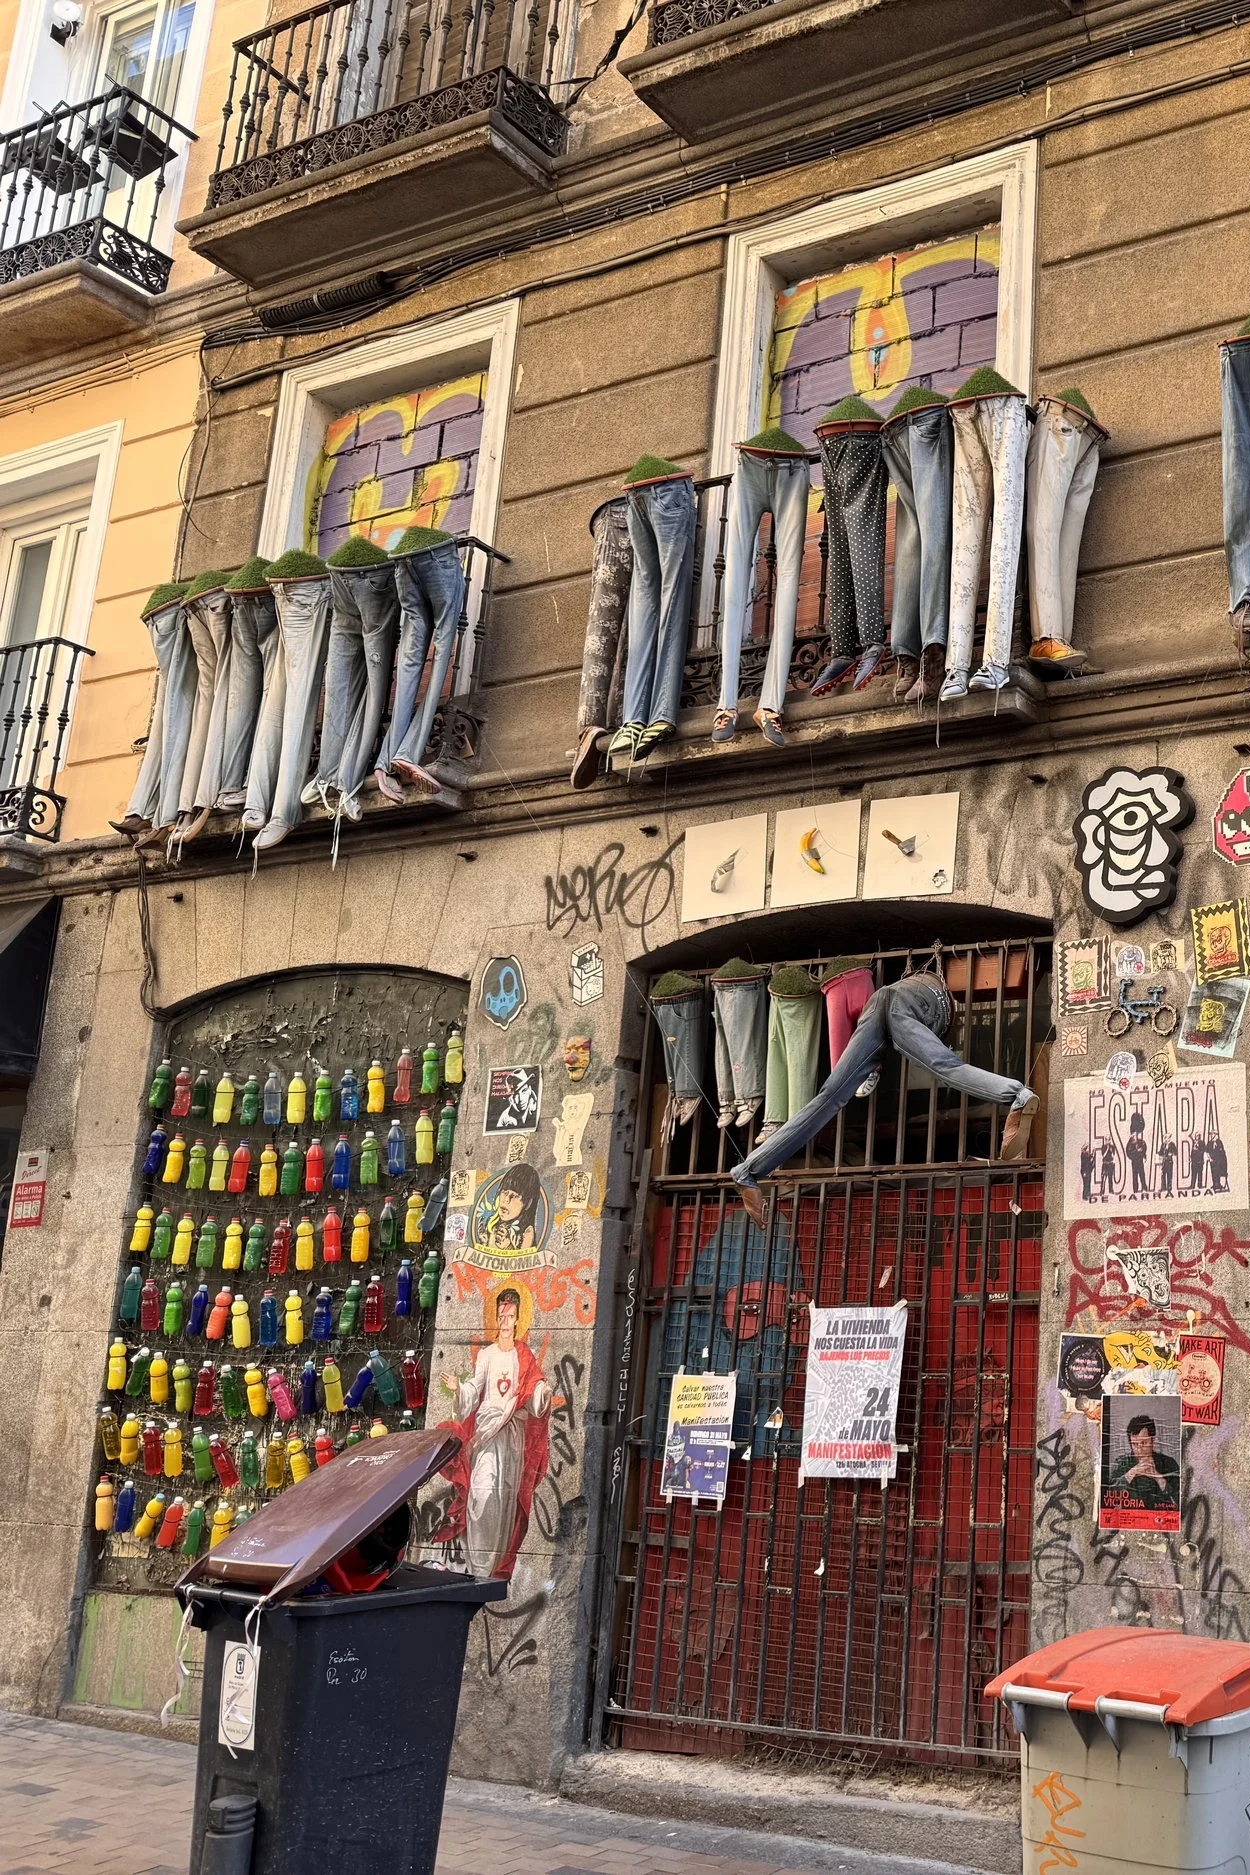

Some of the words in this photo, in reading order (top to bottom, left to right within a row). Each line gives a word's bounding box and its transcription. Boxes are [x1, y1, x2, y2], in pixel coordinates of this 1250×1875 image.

[1089, 1089, 1105, 1098] NO
[1164, 1079, 1216, 1089] MUERTO
[1088, 1084, 1222, 1197] ESTABA
[16, 1185, 43, 1196] Alarma
[1088, 1195, 1109, 1204] DE
[1118, 1188, 1216, 1203] PARRANDA
[468, 1251, 542, 1271] AUTONOMIA
[826, 1320, 839, 1336] LA
[840, 1319, 891, 1336] VIVIENDA
[814, 1338, 835, 1351] NOS
[834, 1337, 867, 1350] CUESTA
[867, 1337, 878, 1350] LA
[879, 1337, 898, 1350] VIDA
[1180, 1338, 1203, 1355] MAKE
[1204, 1340, 1224, 1363] ART
[863, 1387, 891, 1417] 24
[1195, 1396, 1219, 1421] WAR
[838, 1426, 850, 1440] de
[849, 1420, 892, 1442] MAYO
[807, 1441, 893, 1461] MANIFESTACIÓN
[1103, 1489, 1130, 1499] JULIO
[1103, 1498, 1145, 1508] VICTORIA
